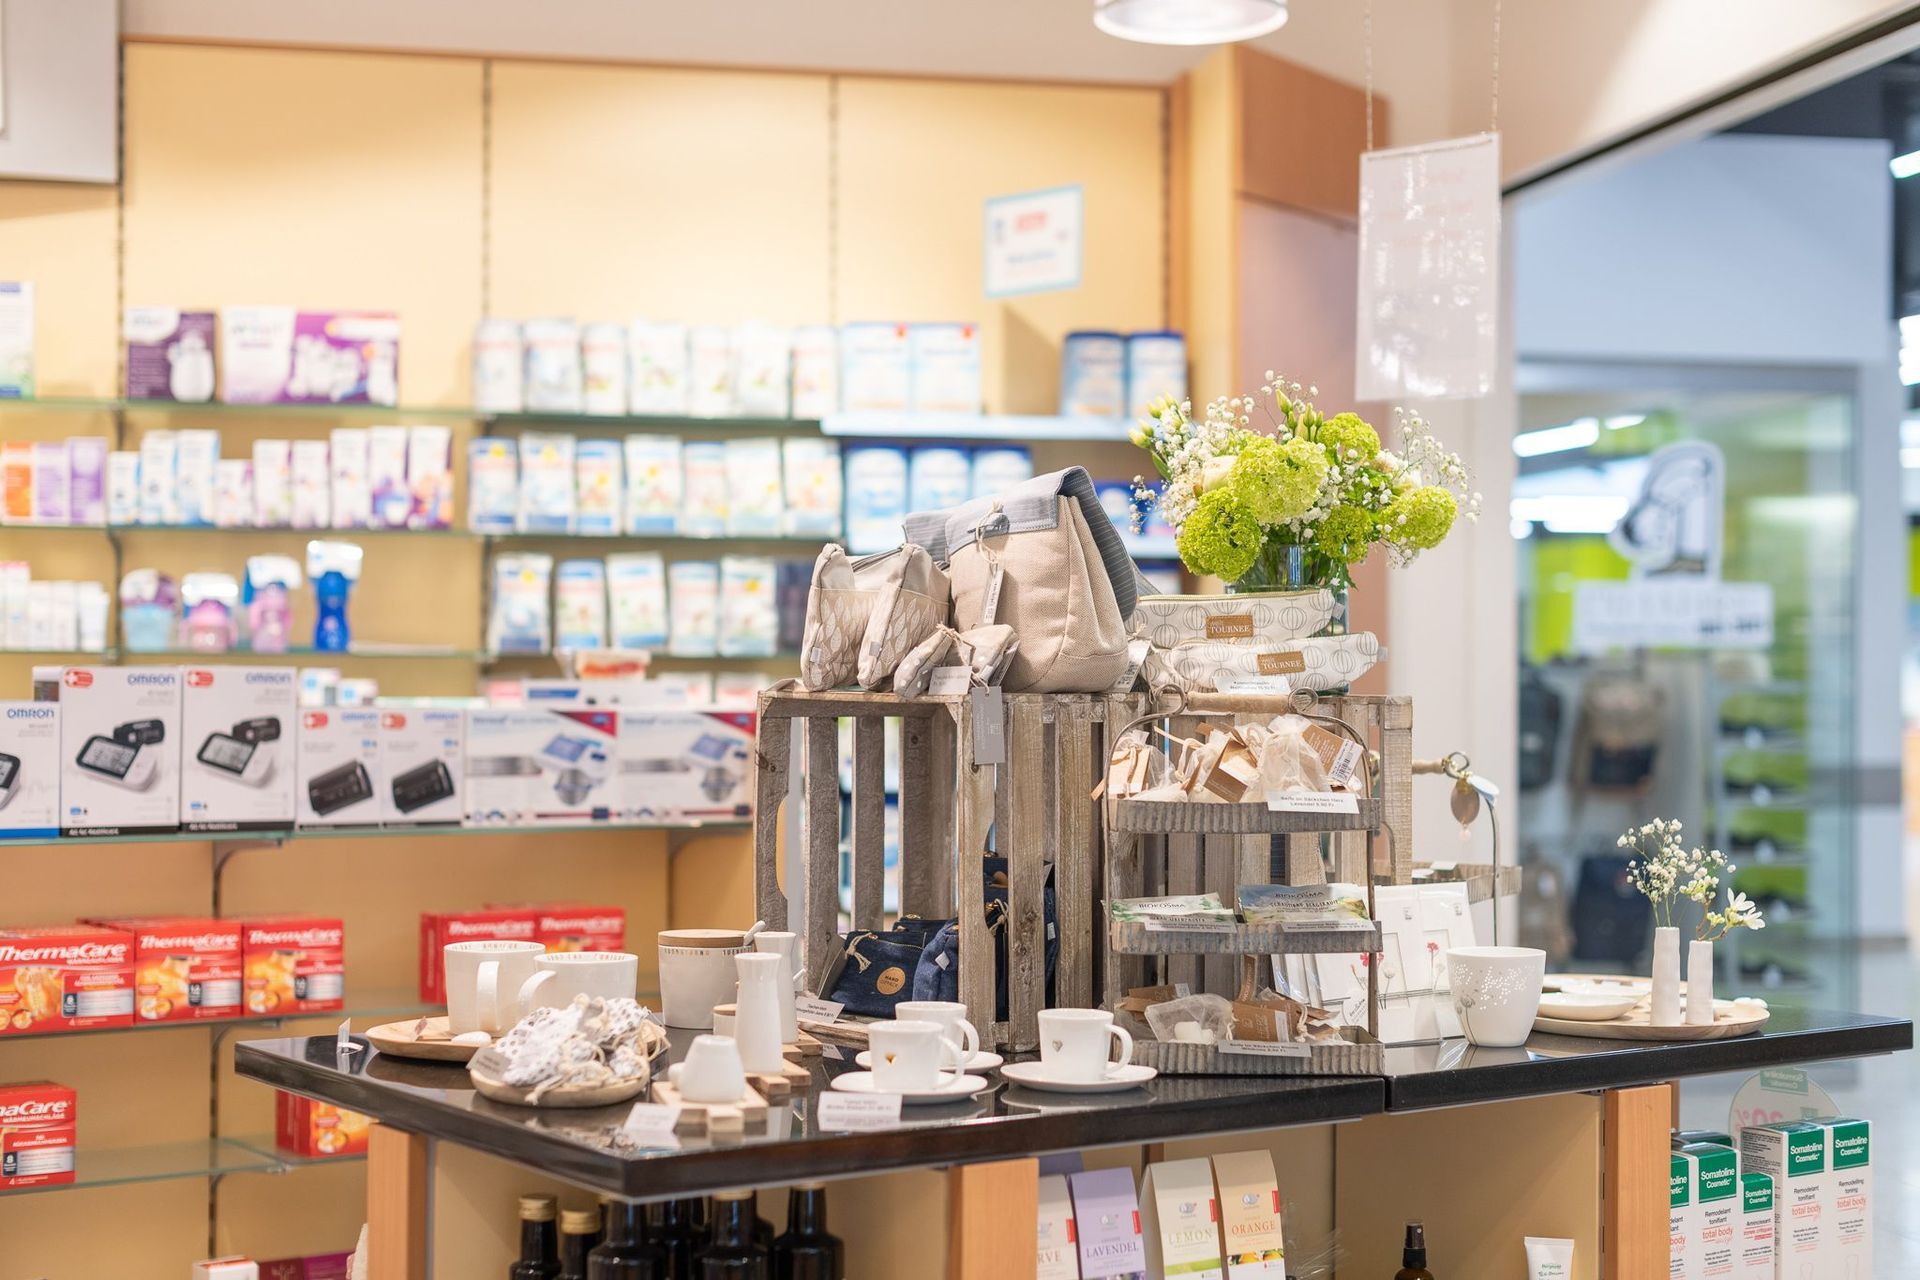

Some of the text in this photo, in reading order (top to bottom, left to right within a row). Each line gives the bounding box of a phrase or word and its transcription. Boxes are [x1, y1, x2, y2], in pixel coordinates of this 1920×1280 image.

[1211, 625, 1250, 634] TOURNEE
[1263, 660, 1302, 670] TOURNEE
[140, 933, 239, 949] ThermaCare
[250, 929, 342, 945] ThermaCare
[0, 942, 127, 961] ThermaCare
[1835, 1136, 1868, 1148] Somatoline
[1790, 1143, 1823, 1155] Somatoline
[1840, 1147, 1864, 1156] Cosmetic
[1795, 1154, 1820, 1163] Cosmetic
[1700, 1167, 1735, 1181] Somatoline
[1706, 1178, 1731, 1189] Cosmetic
[1745, 1188, 1772, 1198] Somatoline
[1705, 1208, 1732, 1218] Remodelant
[1231, 1220, 1276, 1236] ORANGE
[1702, 1226, 1734, 1240] total body
[1168, 1228, 1213, 1245] LEMON
[1086, 1241, 1139, 1258] LAVENDEL
